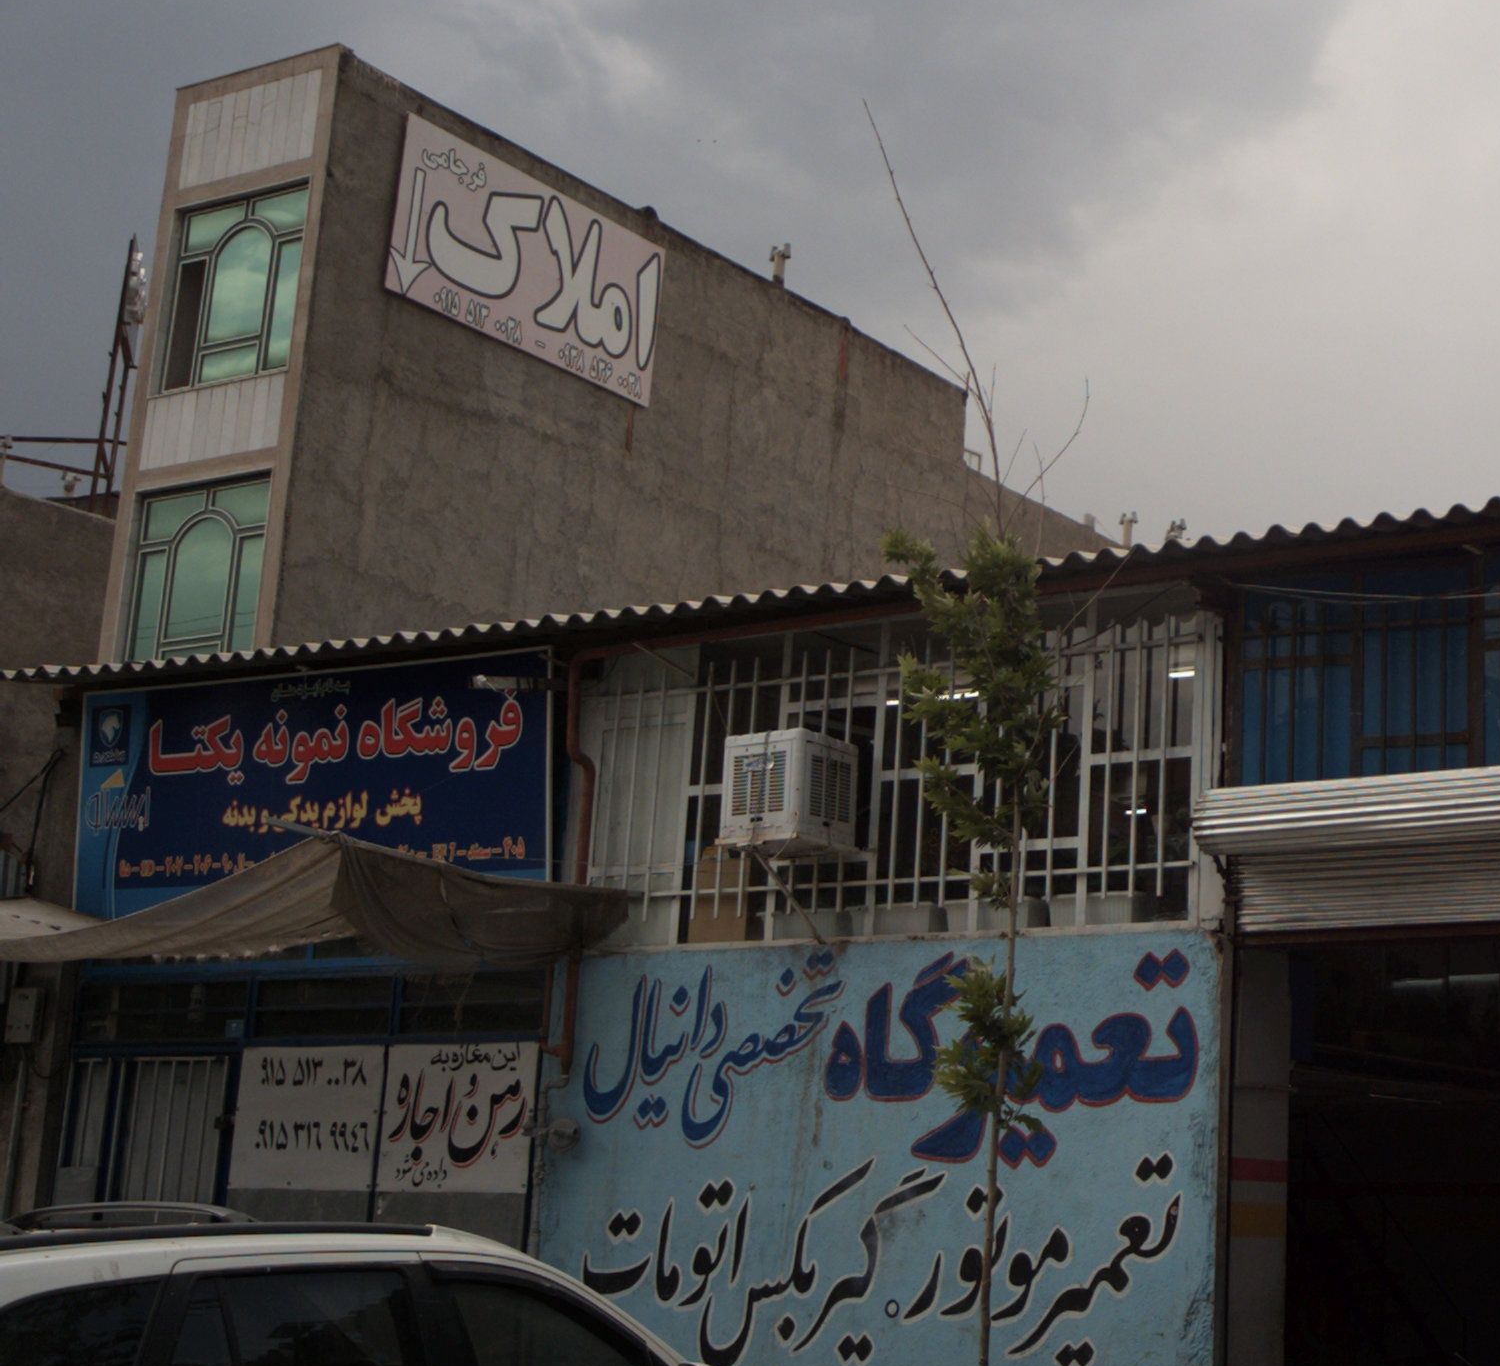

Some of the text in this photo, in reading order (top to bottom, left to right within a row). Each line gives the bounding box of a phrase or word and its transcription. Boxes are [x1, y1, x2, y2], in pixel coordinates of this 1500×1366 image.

[426, 190, 661, 372] املاک
[149, 687, 524, 786] فروشگاه نمونه یکتا
[221, 798, 257, 834] بدنه
[322, 787, 370, 830] لوازم
[374, 786, 424, 828] پخش
[430, 1049, 450, 1072] به
[491, 1041, 521, 1071] این
[583, 948, 1200, 1169] تعمیرگاه تخصصی دانیال
[387, 1067, 457, 1165] اجاره
[448, 1078, 527, 1168] رهن
[582, 1179, 750, 1310] اتومات
[902, 1185, 1070, 1321] موتور
